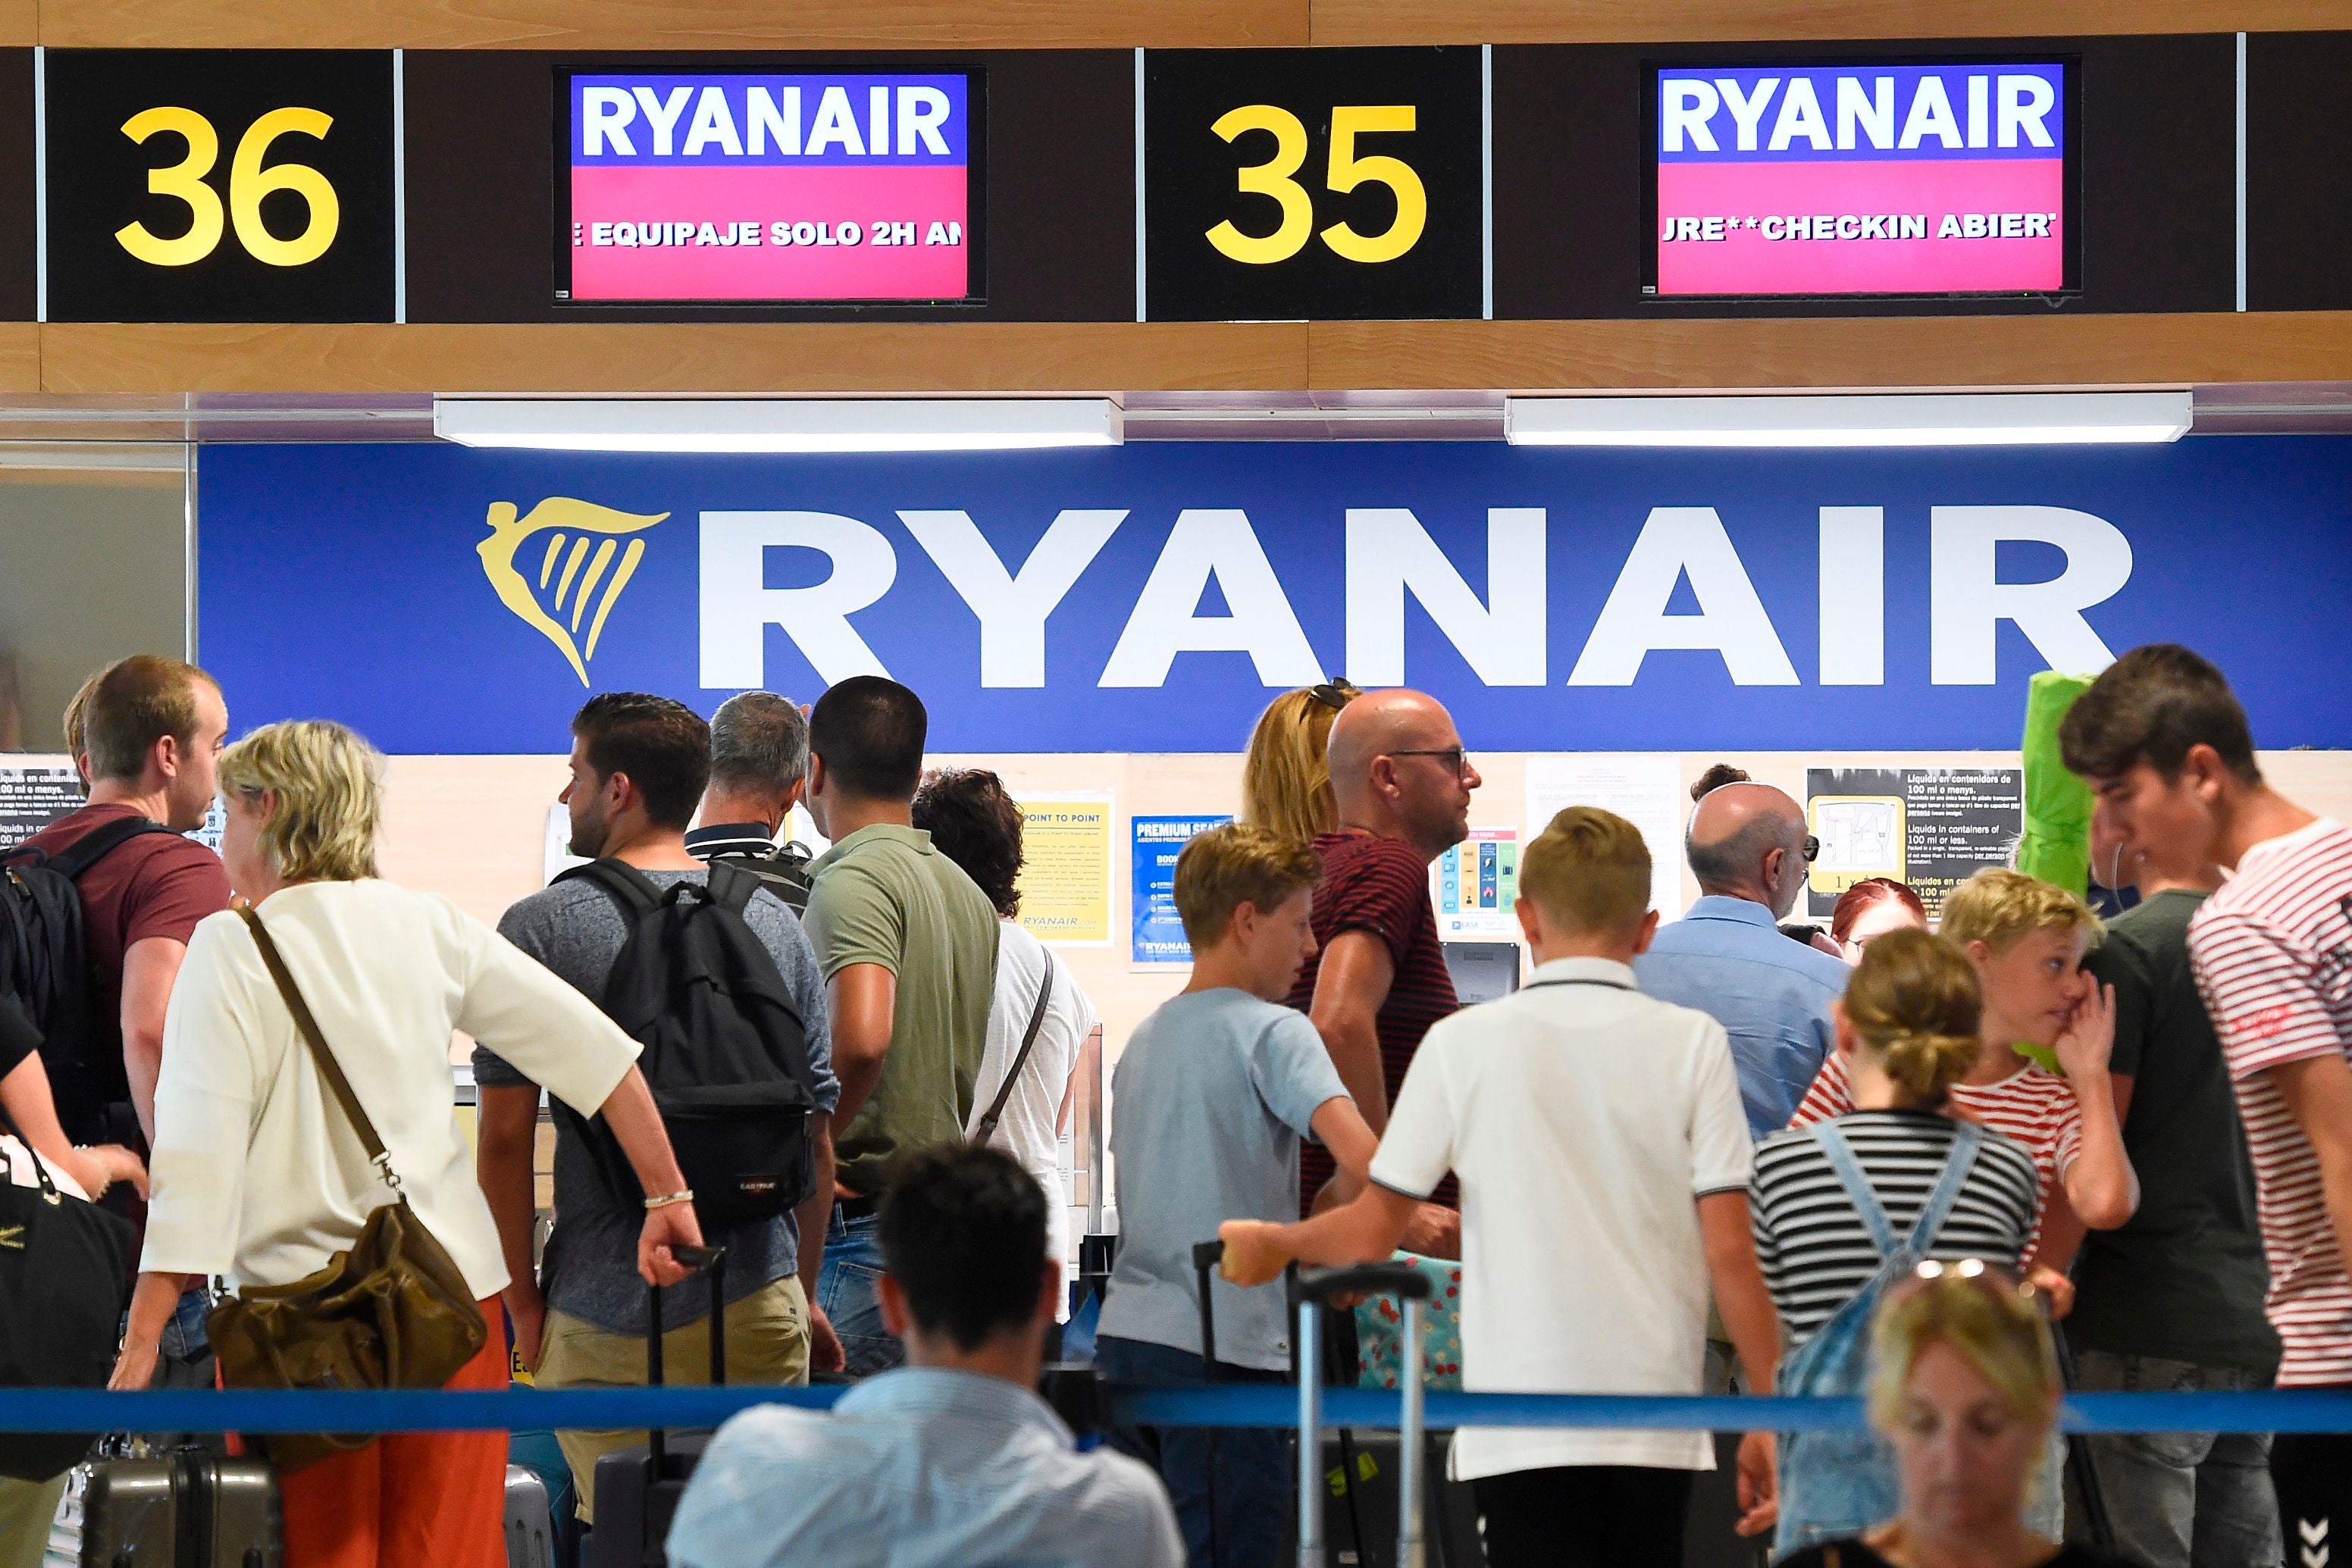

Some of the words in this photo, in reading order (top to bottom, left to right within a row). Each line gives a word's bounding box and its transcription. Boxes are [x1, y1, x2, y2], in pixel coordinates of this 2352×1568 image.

[1662, 74, 2055, 152] RYANAIR
[583, 86, 951, 156] RYANAIR
[115, 107, 340, 267] 36
[1205, 105, 1427, 264] 35
[1936, 212, 2056, 238] ABIER
[591, 221, 762, 248] EQUIPAJE
[769, 221, 863, 246] SOLO
[870, 221, 916, 246] 2H
[699, 505, 2134, 689] RYANAIR
[1, 784, 13, 793] 00
[1908, 785, 1925, 794] 100
[1927, 785, 1937, 794] ml
[1056, 814, 1068, 822] TO
[1136, 823, 1192, 837] PREMIUM
[1908, 825, 1936, 834] Liquids
[1938, 825, 1946, 833] in
[1948, 825, 1990, 834] containers
[1991, 825, 2000, 834] of
[0, 834, 12, 844] 00
[1908, 835, 1925, 844] 100
[1927, 835, 1937, 844] ml
[1950, 835, 1968, 844] less.
[1920, 887, 1937, 897] 100
[1024, 917, 1078, 925] RYANAIR
